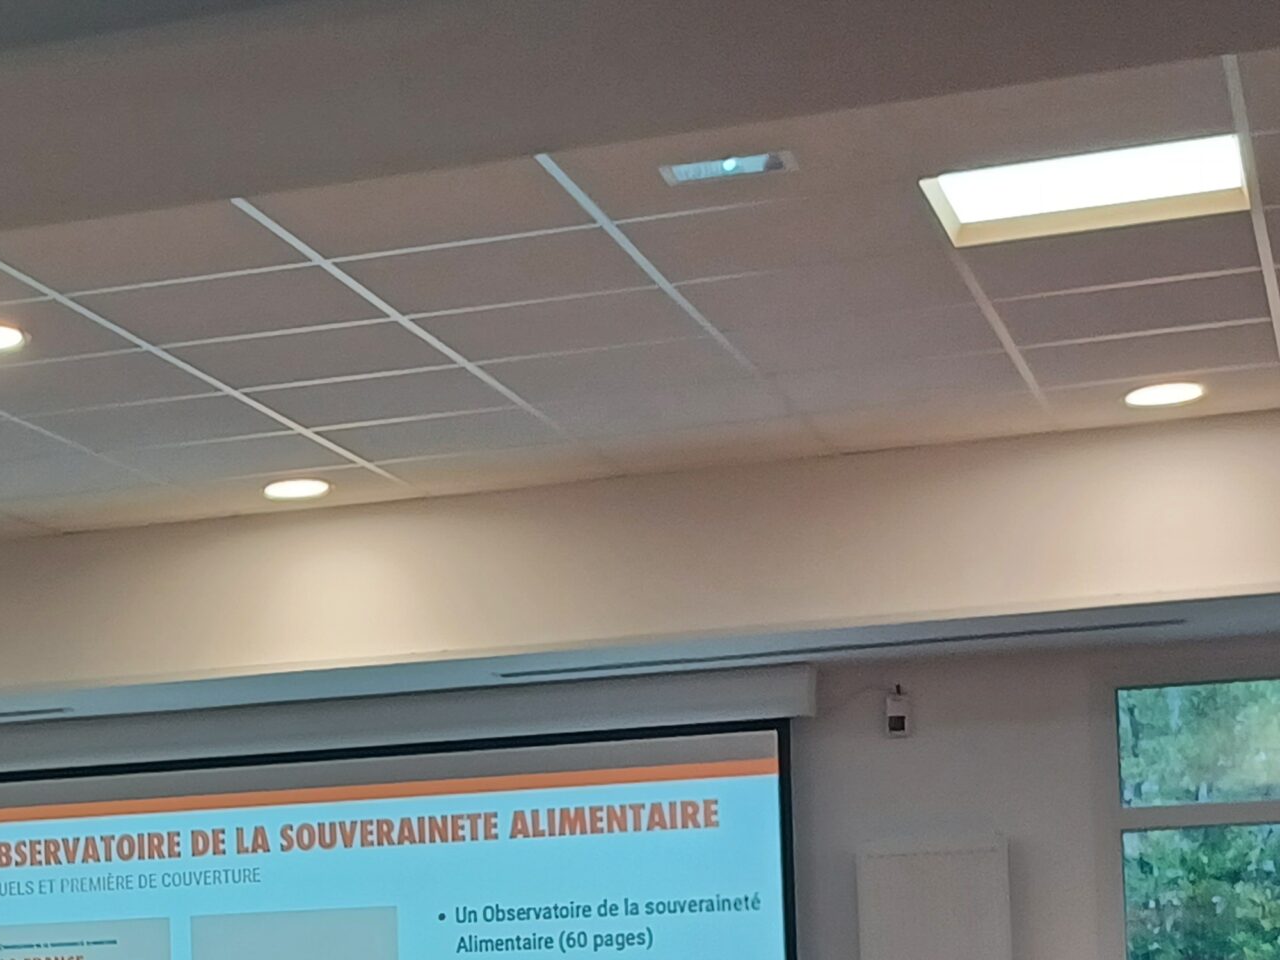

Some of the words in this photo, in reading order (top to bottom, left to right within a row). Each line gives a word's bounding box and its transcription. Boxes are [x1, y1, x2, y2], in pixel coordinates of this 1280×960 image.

[191, 829, 227, 857] DE
[236, 825, 271, 853] LA
[280, 811, 499, 851] SOUVERAINETE
[509, 799, 719, 839] ALIMENTAIRE
[39, 879, 56, 894] ET
[60, 872, 134, 893] PREMIÈRE
[139, 873, 158, 889] DE
[162, 867, 262, 888] COUVERTURE
[455, 906, 478, 924] Un
[483, 899, 593, 923] Observatoire
[597, 899, 620, 917] de
[624, 898, 640, 916] la
[645, 892, 761, 915] souveraineté
[456, 932, 554, 953] Alimentaire
[558, 930, 588, 953] (60
[593, 926, 654, 951] pages)
